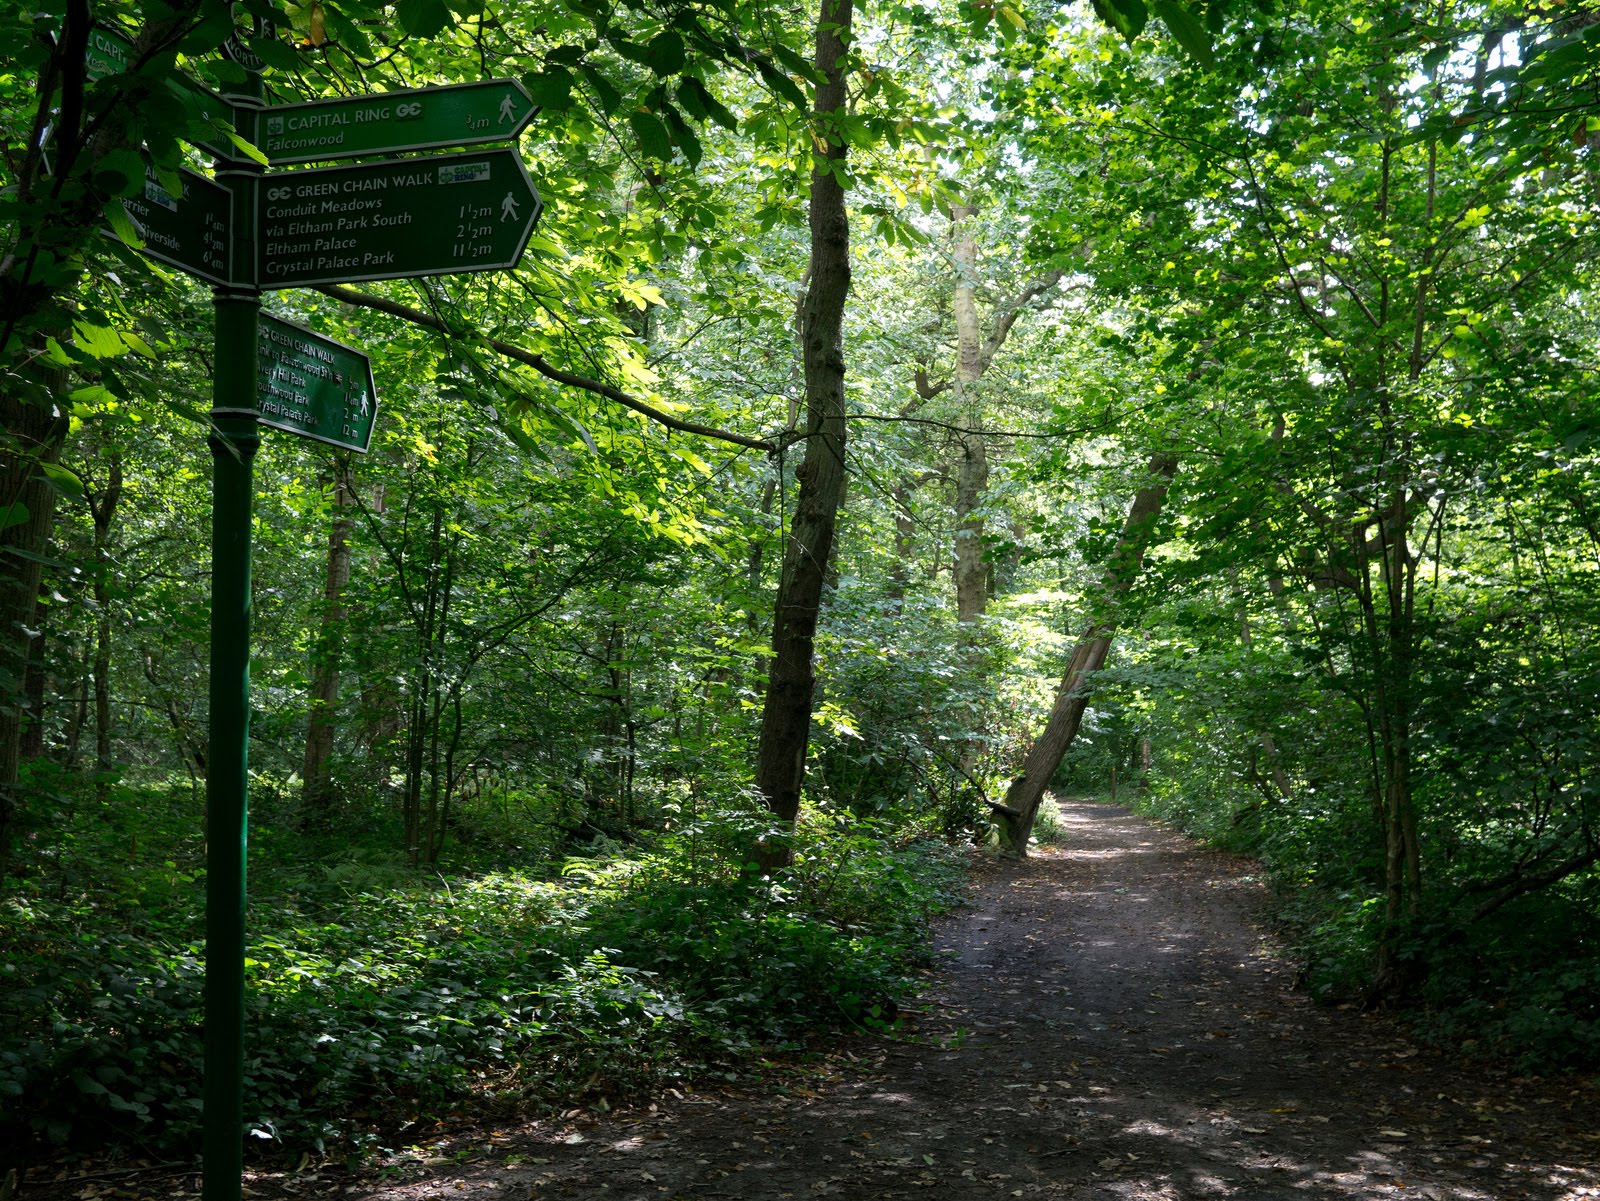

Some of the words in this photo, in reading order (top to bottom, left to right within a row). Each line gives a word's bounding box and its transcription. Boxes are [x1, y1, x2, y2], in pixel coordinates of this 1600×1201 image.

[288, 113, 351, 130] CAPITAL
[355, 108, 390, 122] RING
[266, 131, 344, 151] Falconwood
[296, 182, 339, 197] GREEN
[343, 178, 387, 192] CHAIN
[392, 172, 433, 187] WALK
[119, 197, 150, 216] arrier
[266, 202, 317, 219] Conduit
[321, 198, 382, 213] Meadows
[266, 225, 284, 237] via
[288, 221, 333, 235] Eltham
[337, 216, 368, 231] Park
[372, 211, 413, 227] South
[266, 242, 311, 256] Eltham
[314, 237, 357, 251] Palace
[266, 257, 313, 276] Crystal
[317, 255, 360, 270] Palace
[363, 250, 395, 265] Park
[258, 343, 270, 358] ink
[272, 350, 280, 360] to
[270, 330, 293, 349] GREEN
[294, 340, 316, 357] CHAIN
[317, 350, 336, 366] WALK
[278, 367, 290, 382] Hill
[290, 372, 306, 388] Park
[257, 380, 294, 400] outhwood
[294, 391, 310, 406] Park
[281, 405, 303, 421] Palace
